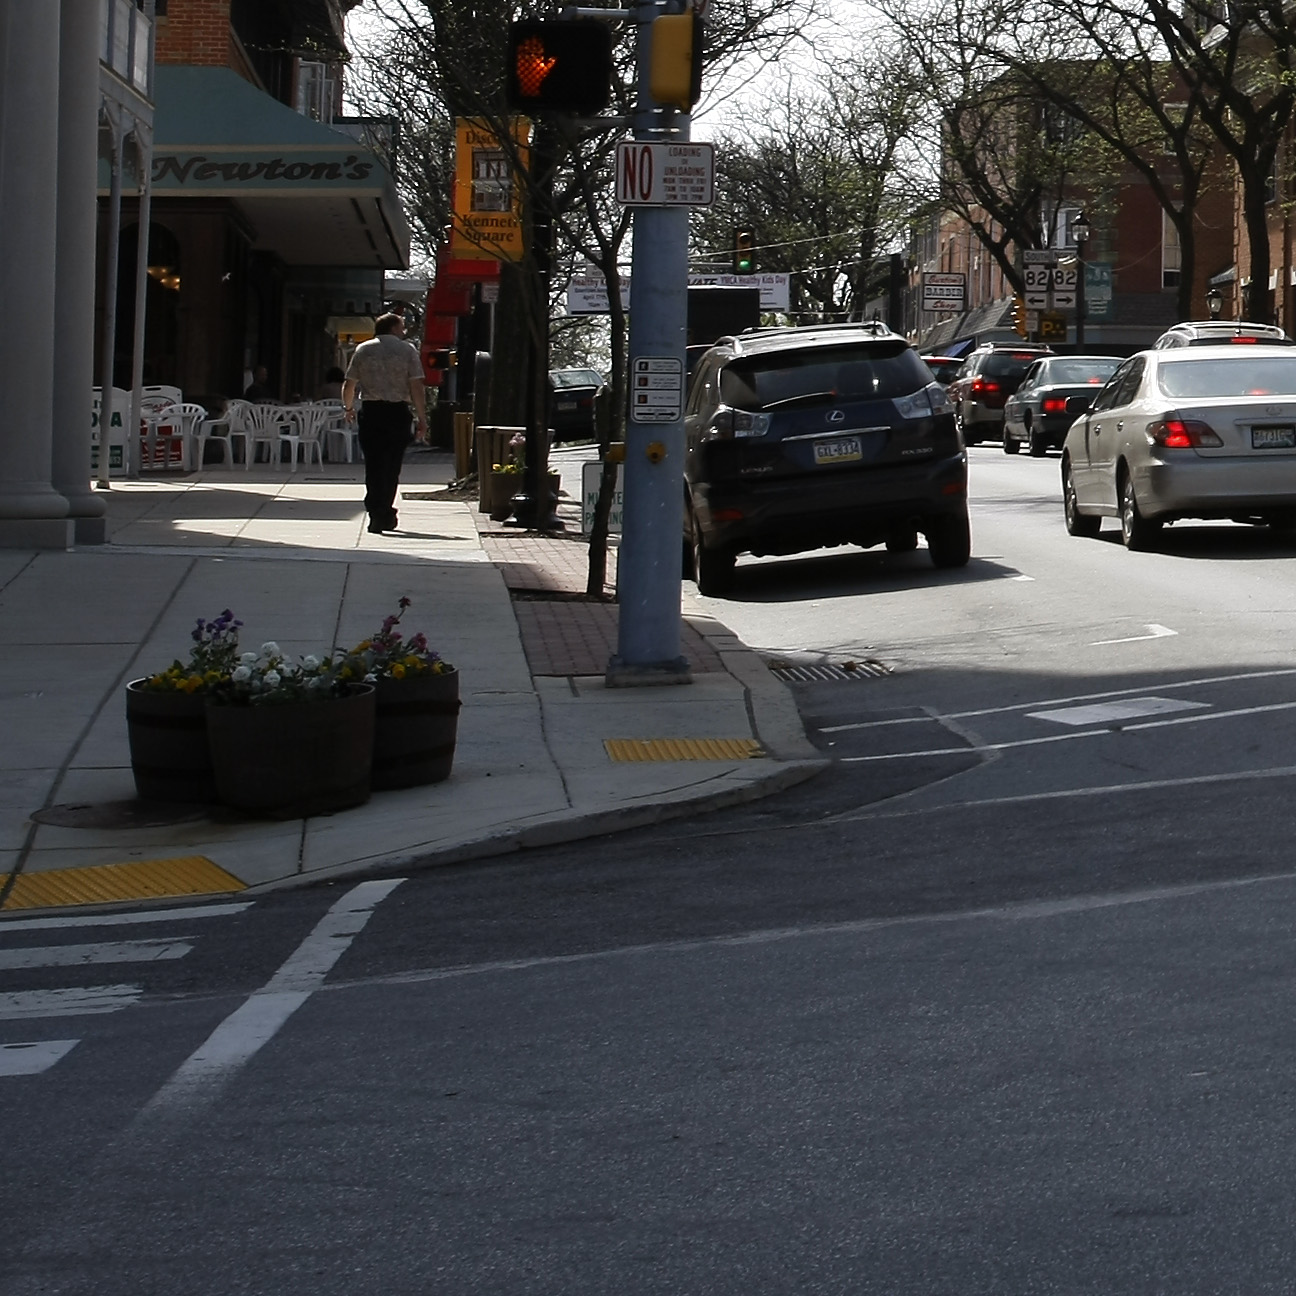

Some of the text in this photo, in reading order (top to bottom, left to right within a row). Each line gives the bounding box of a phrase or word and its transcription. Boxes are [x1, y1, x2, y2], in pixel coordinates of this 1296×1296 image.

[668, 147, 702, 157] LOADING
[151, 155, 374, 185] Newton's
[622, 145, 654, 201] NO
[664, 166, 706, 176] UNLOADING
[464, 227, 515, 244] Square
[1025, 270, 1048, 286] 82
[1054, 270, 1077, 286] 82
[925, 287, 963, 297] BARBER
[931, 300, 956, 310] Shop
